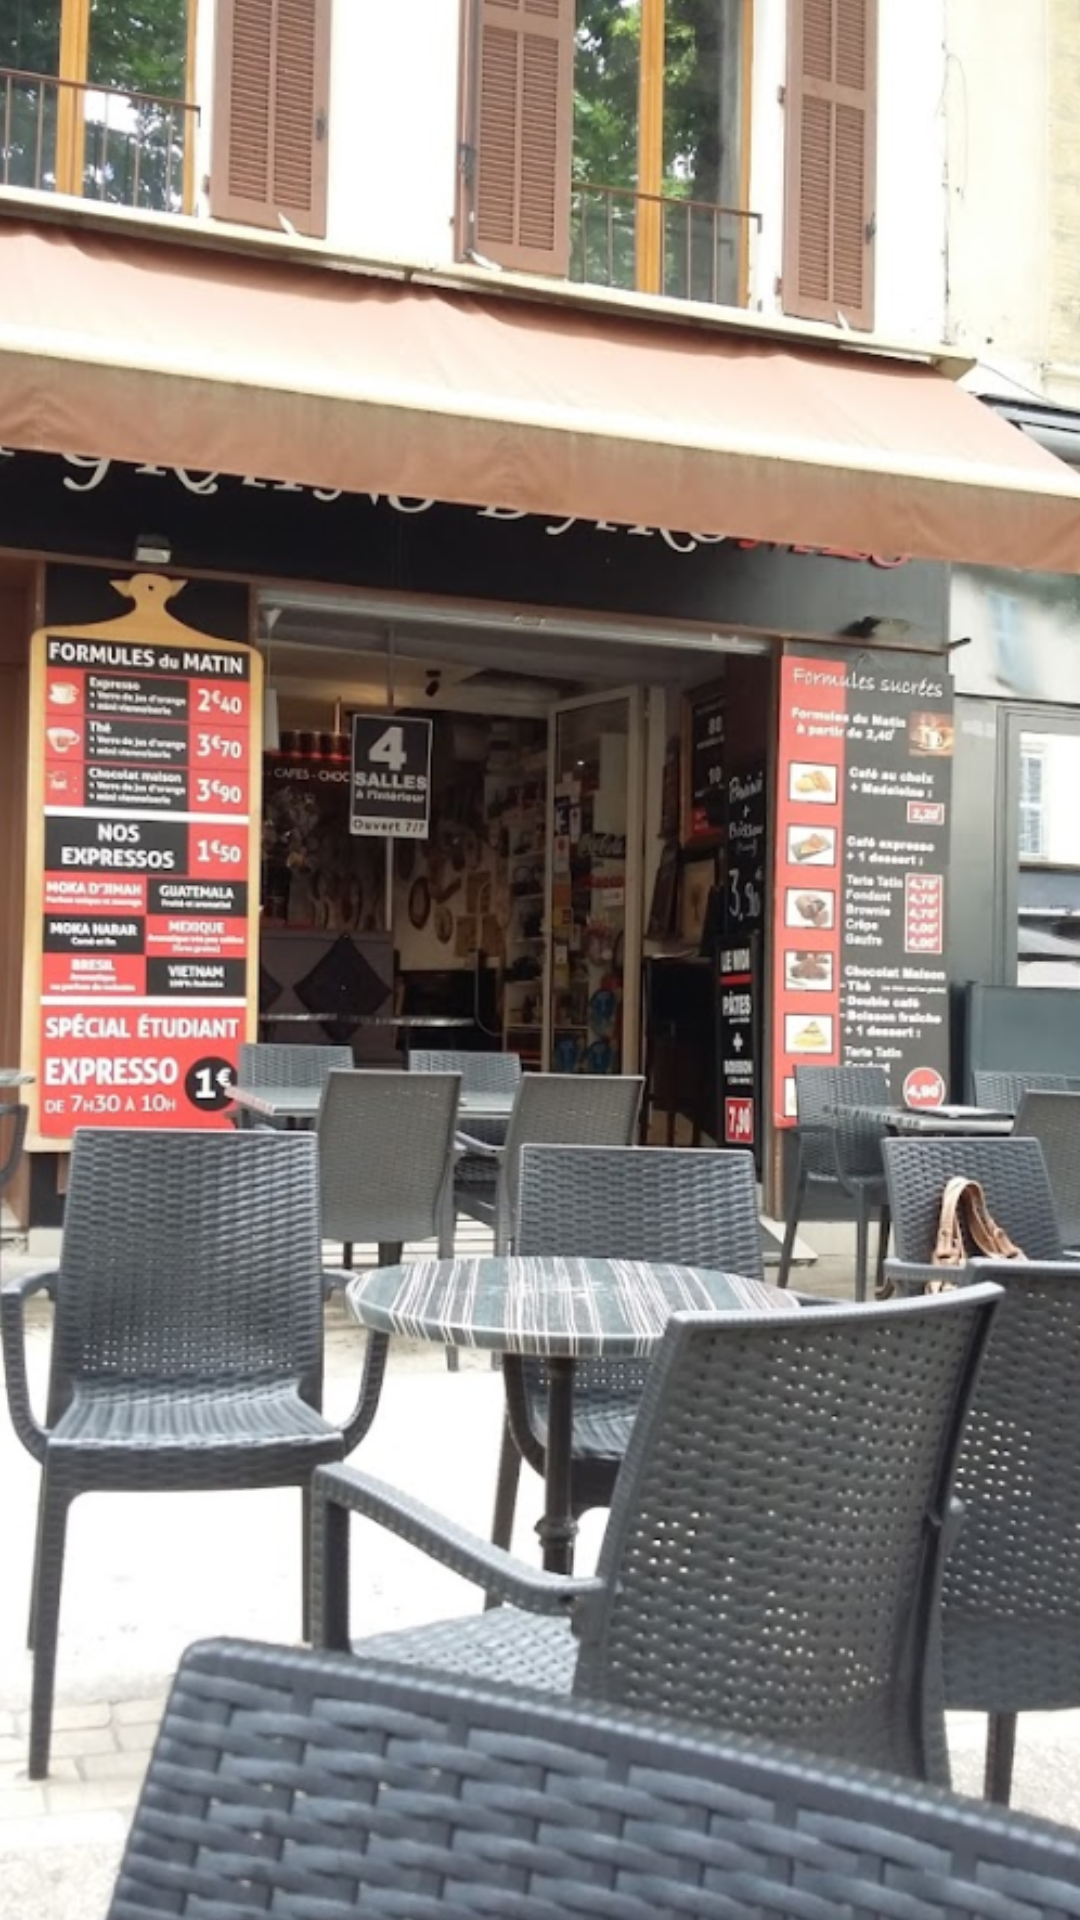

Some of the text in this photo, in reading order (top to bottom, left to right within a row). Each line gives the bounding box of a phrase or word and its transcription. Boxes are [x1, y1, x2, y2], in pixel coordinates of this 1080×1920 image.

[49, 642, 243, 675] FORMULES du MATIN
[89, 677, 140, 691] Expresso
[793, 668, 943, 698] Formules sucrées
[121, 693, 133, 702] de
[792, 707, 906, 728] Formules du Matin
[89, 721, 111, 734] Thé
[796, 722, 805, 734] à
[807, 724, 844, 738] partir
[847, 727, 862, 739] de
[121, 736, 133, 746] de
[368, 726, 407, 772] 4
[89, 768, 182, 784] Chocolat maison
[354, 772, 427, 790] SALLES
[849, 766, 934, 785] Café au choix
[121, 783, 133, 792] de
[356, 788, 425, 803] à l'intérieur
[98, 824, 140, 842] NOS
[354, 819, 400, 833] Ouvert
[846, 835, 934, 853] Café expresso
[61, 847, 175, 869] EXPRESSOS
[868, 853, 916, 866] dessert
[46, 881, 86, 895] MOKA
[846, 874, 904, 888] Tarte Tatin
[159, 885, 235, 899] GUATEMALA
[846, 889, 892, 902] Fondant
[846, 903, 891, 917] Brownie
[50, 922, 139, 936] MOKA HARAR
[169, 920, 225, 935] MEXIQUE
[845, 933, 883, 946] Gaufre
[167, 964, 224, 978] VIETNAM
[844, 965, 946, 980] Chocolat Maison
[847, 980, 871, 992] Thé
[847, 995, 890, 1007] Double
[892, 998, 920, 1008] café
[847, 1009, 896, 1021] Boisson
[45, 1013, 239, 1039] SPÉCIAL ÉTUDIANT
[866, 1026, 914, 1038] dessert
[844, 1046, 902, 1058] Tarte Tatin
[45, 1057, 179, 1085] EXPRESSO
[196, 1067, 232, 1099] 1€
[45, 1099, 64, 1113] DE
